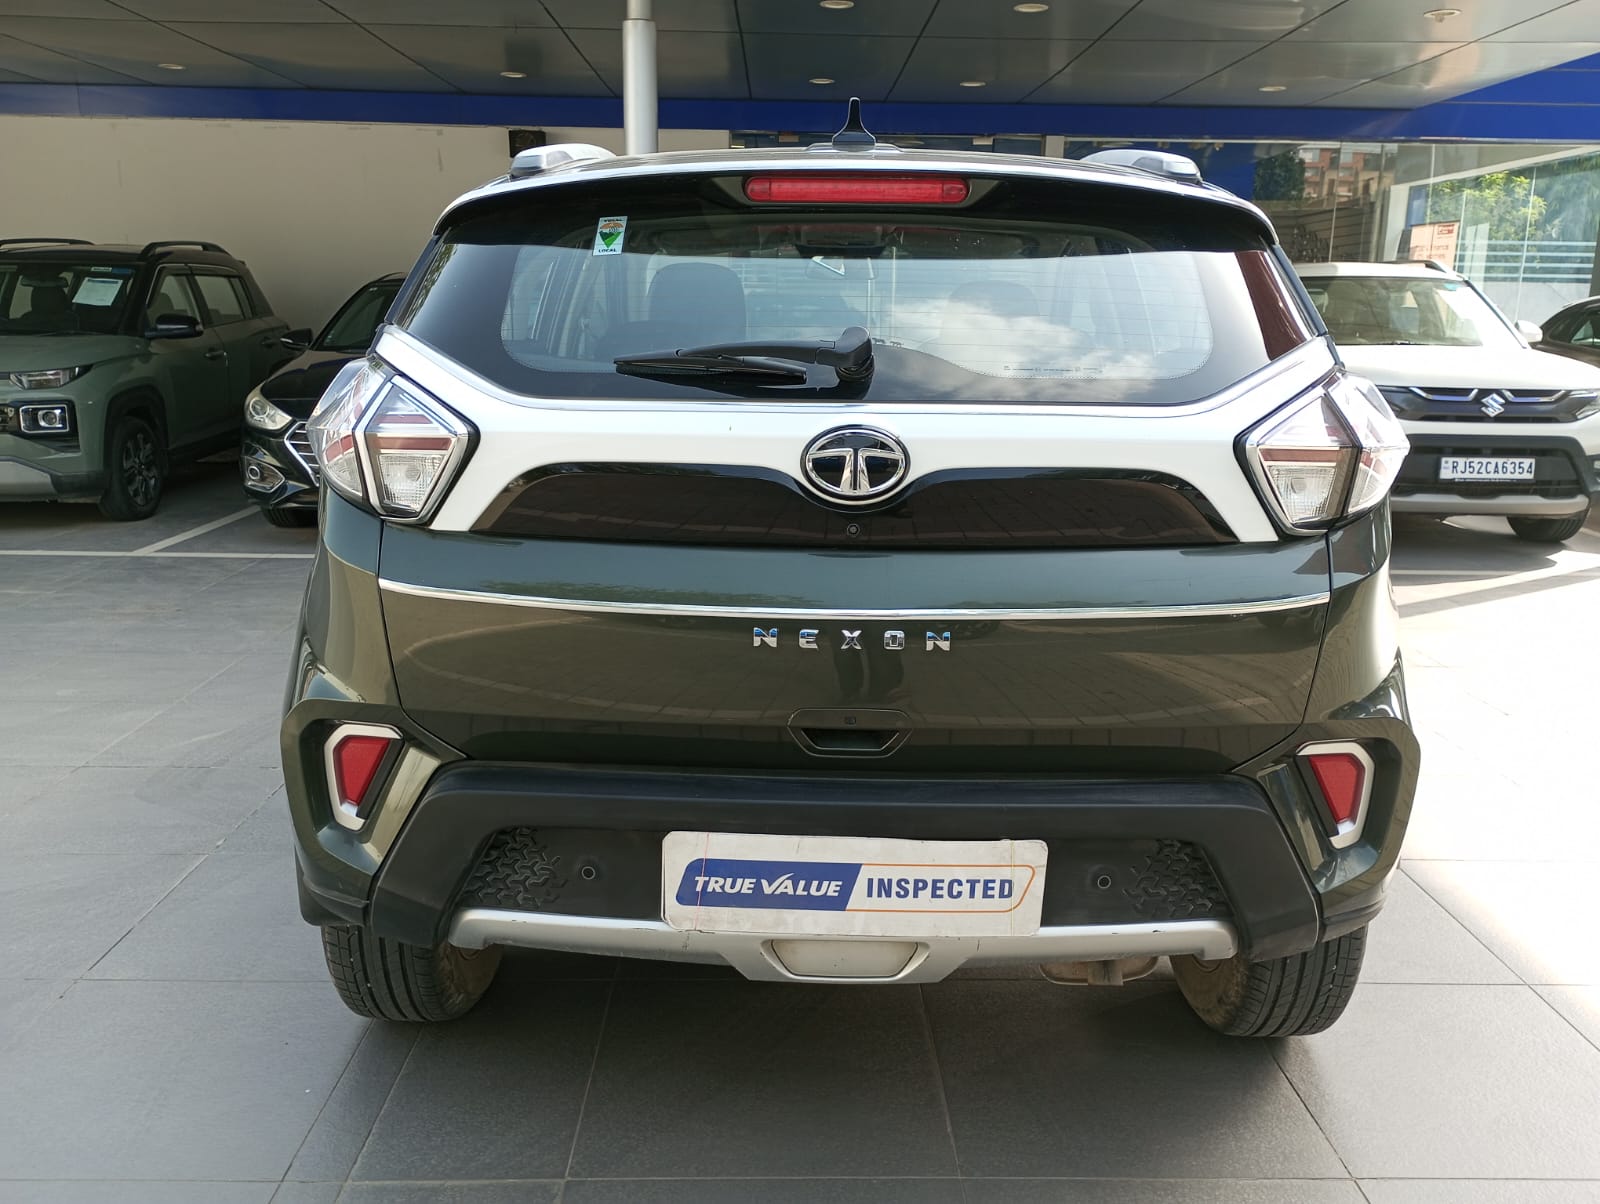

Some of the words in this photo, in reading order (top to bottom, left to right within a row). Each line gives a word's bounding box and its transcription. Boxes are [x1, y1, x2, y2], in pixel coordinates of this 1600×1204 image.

[1451, 460, 1533, 475] RJ52CA6354
[753, 627, 951, 651] NEXON
[694, 876, 755, 894] TRUE
[760, 872, 843, 897] VALUE
[866, 877, 1014, 900] INSPECTED
